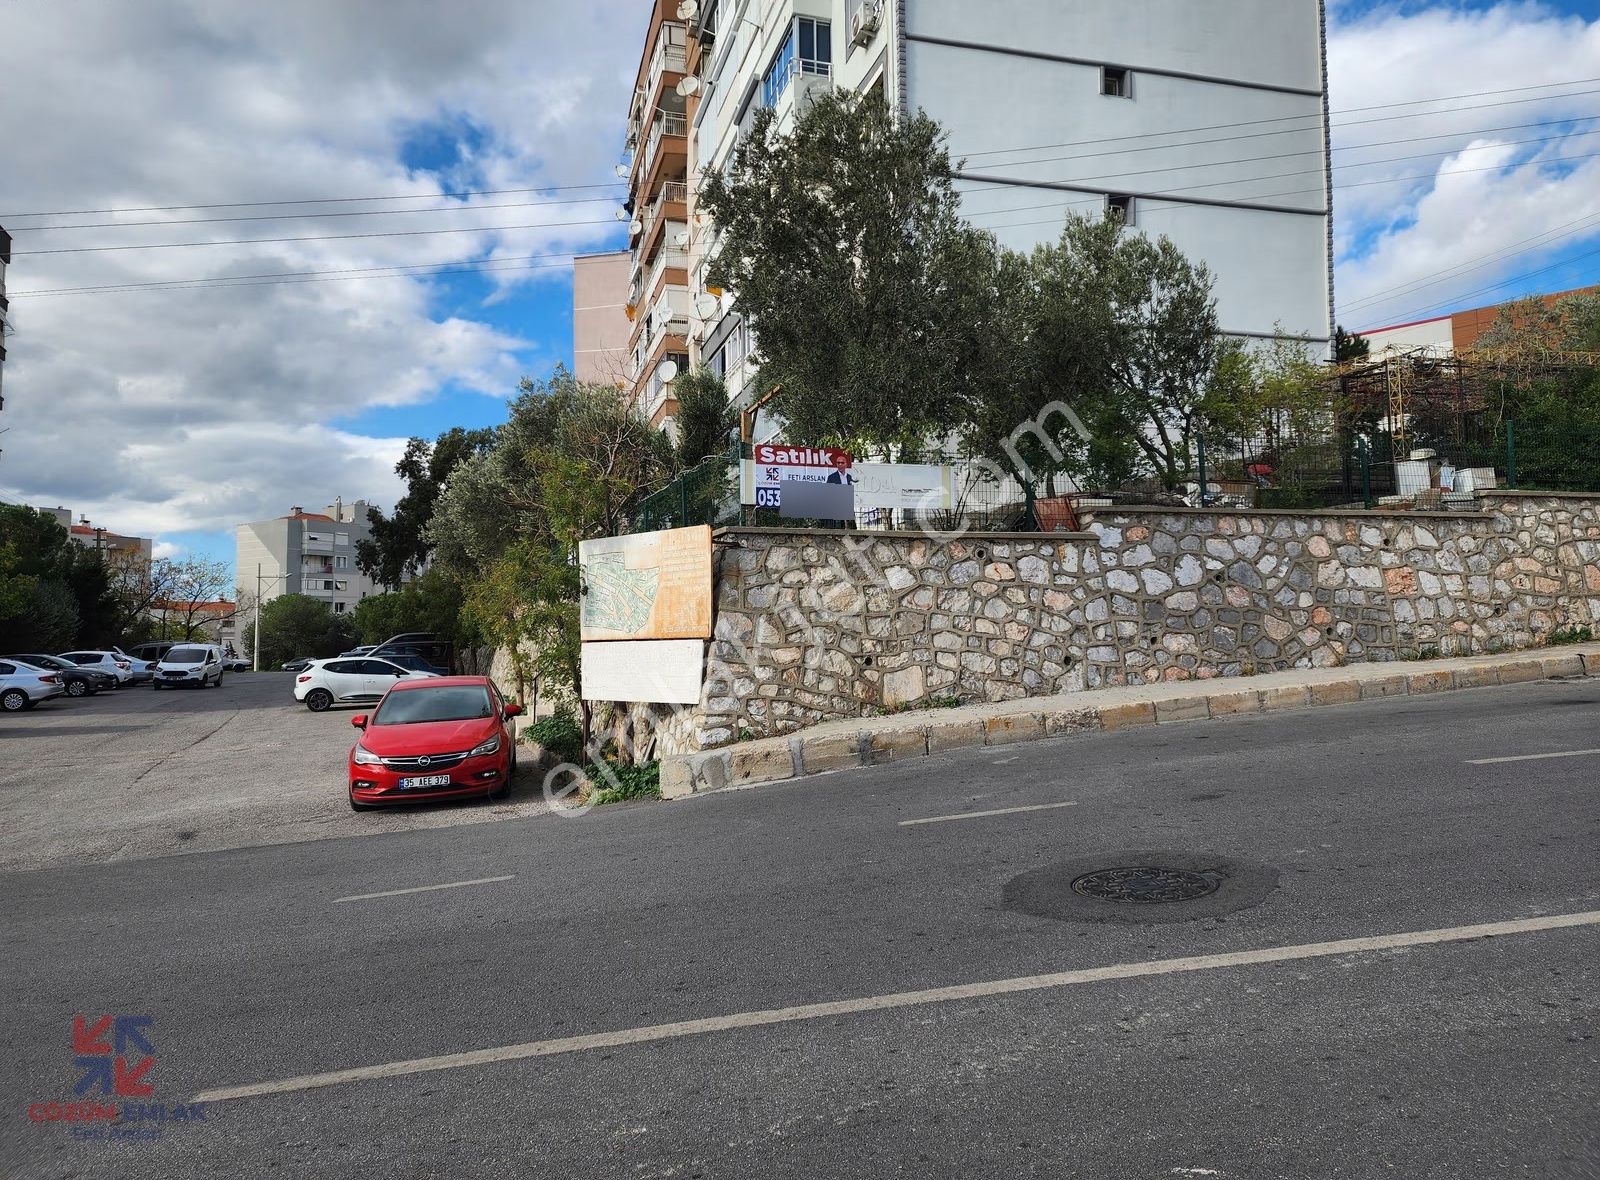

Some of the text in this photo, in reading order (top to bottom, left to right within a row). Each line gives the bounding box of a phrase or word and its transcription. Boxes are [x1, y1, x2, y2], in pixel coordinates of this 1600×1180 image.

[760, 447, 833, 465] Satılık
[419, 777, 432, 785] AEE
[435, 776, 448, 784] 379
